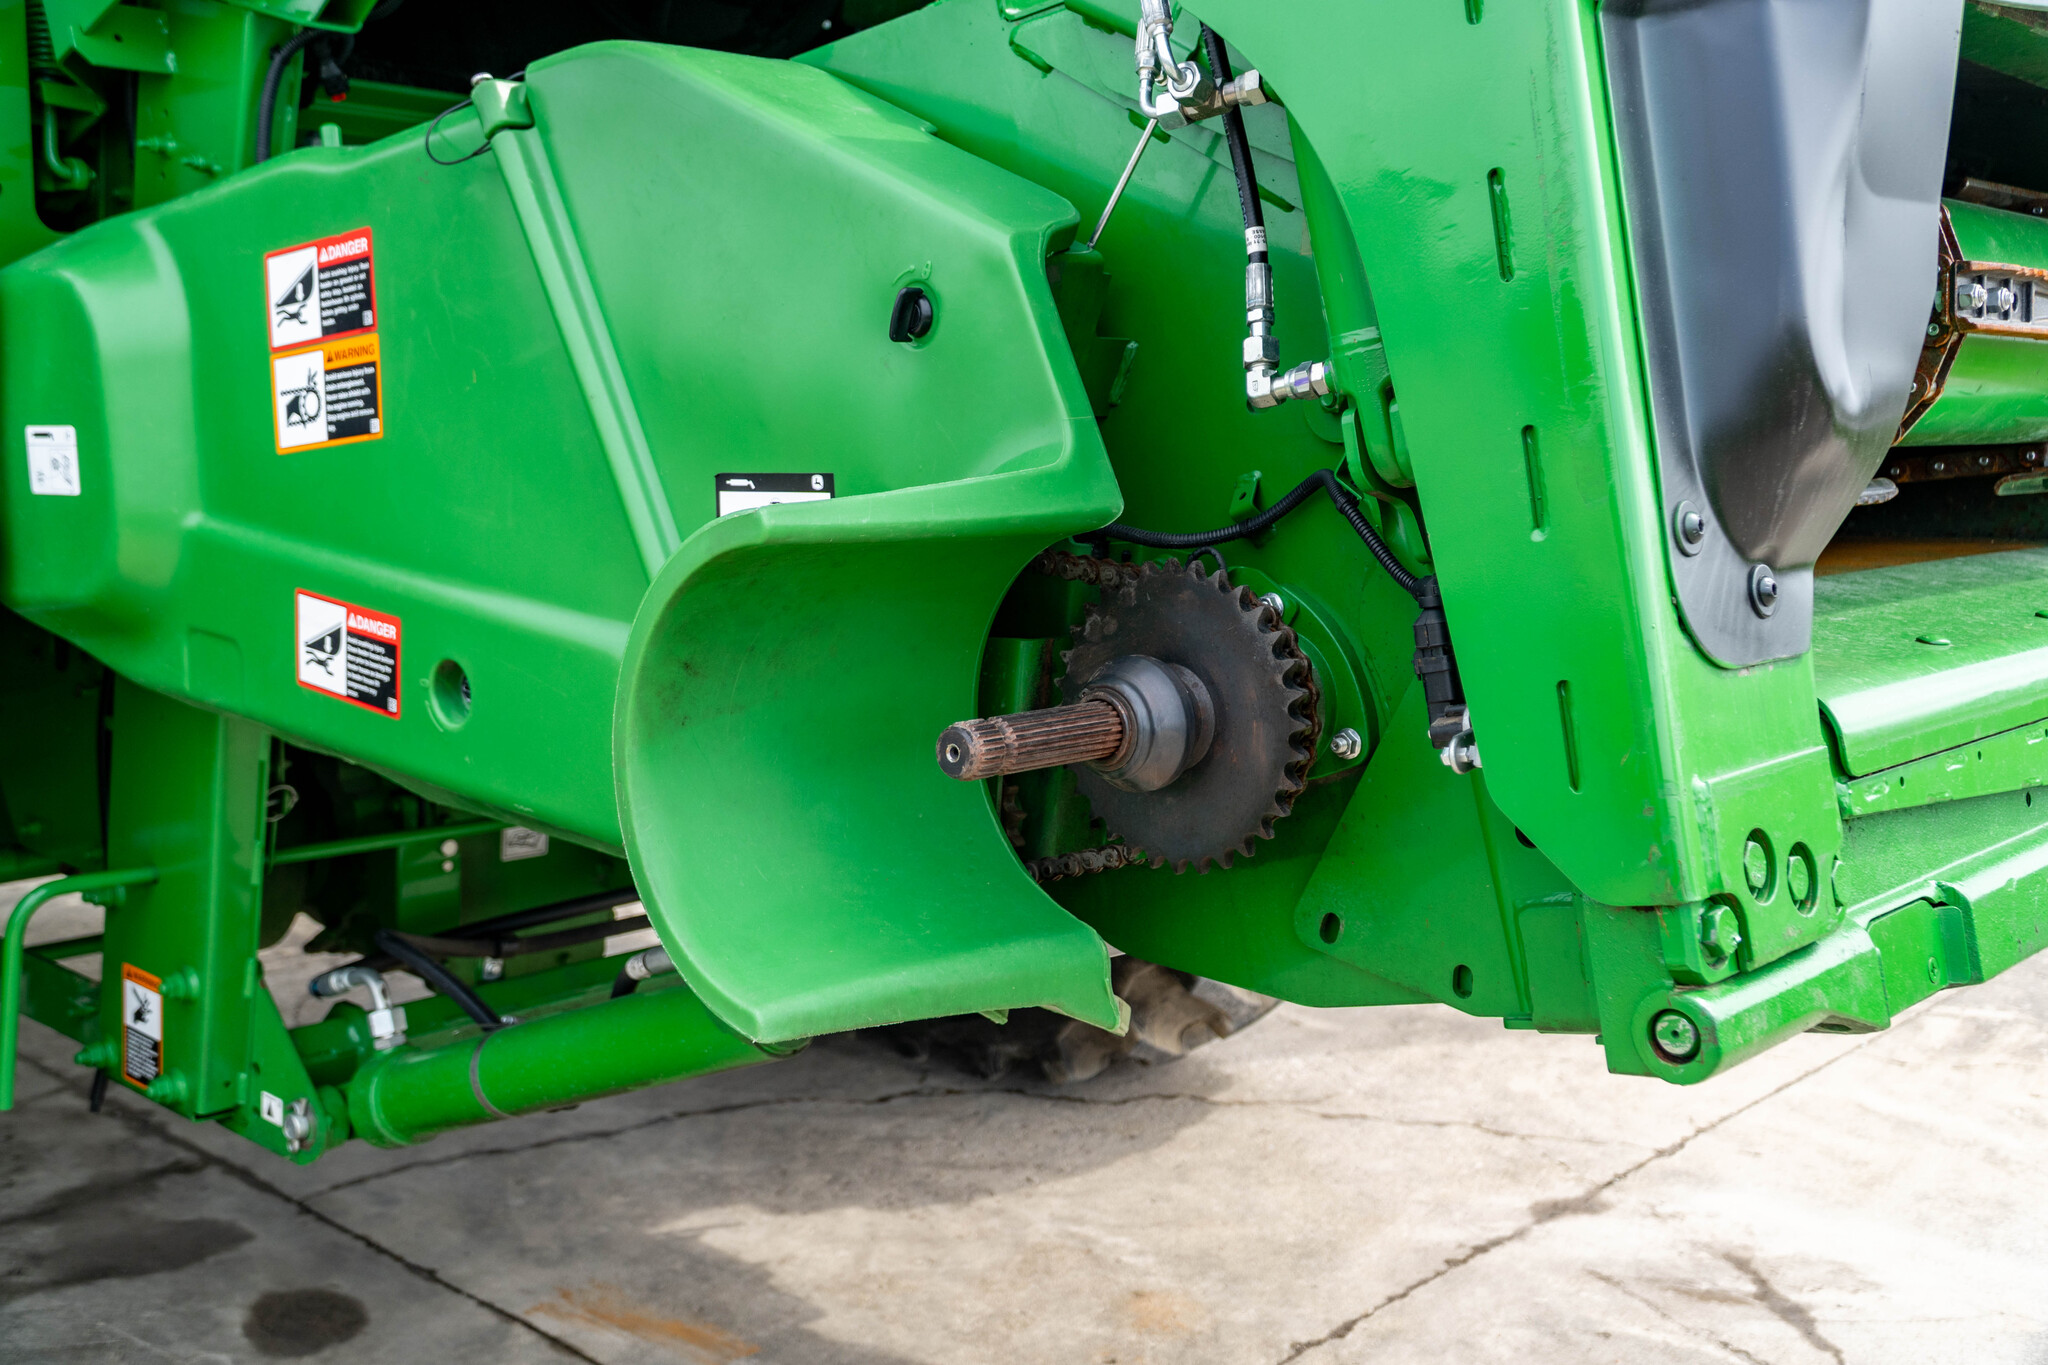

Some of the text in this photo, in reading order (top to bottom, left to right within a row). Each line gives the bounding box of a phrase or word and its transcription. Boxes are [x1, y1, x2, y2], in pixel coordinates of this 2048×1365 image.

[326, 237, 368, 261] DANGER
[334, 343, 375, 361] WARNING
[356, 614, 396, 640] DANGER
